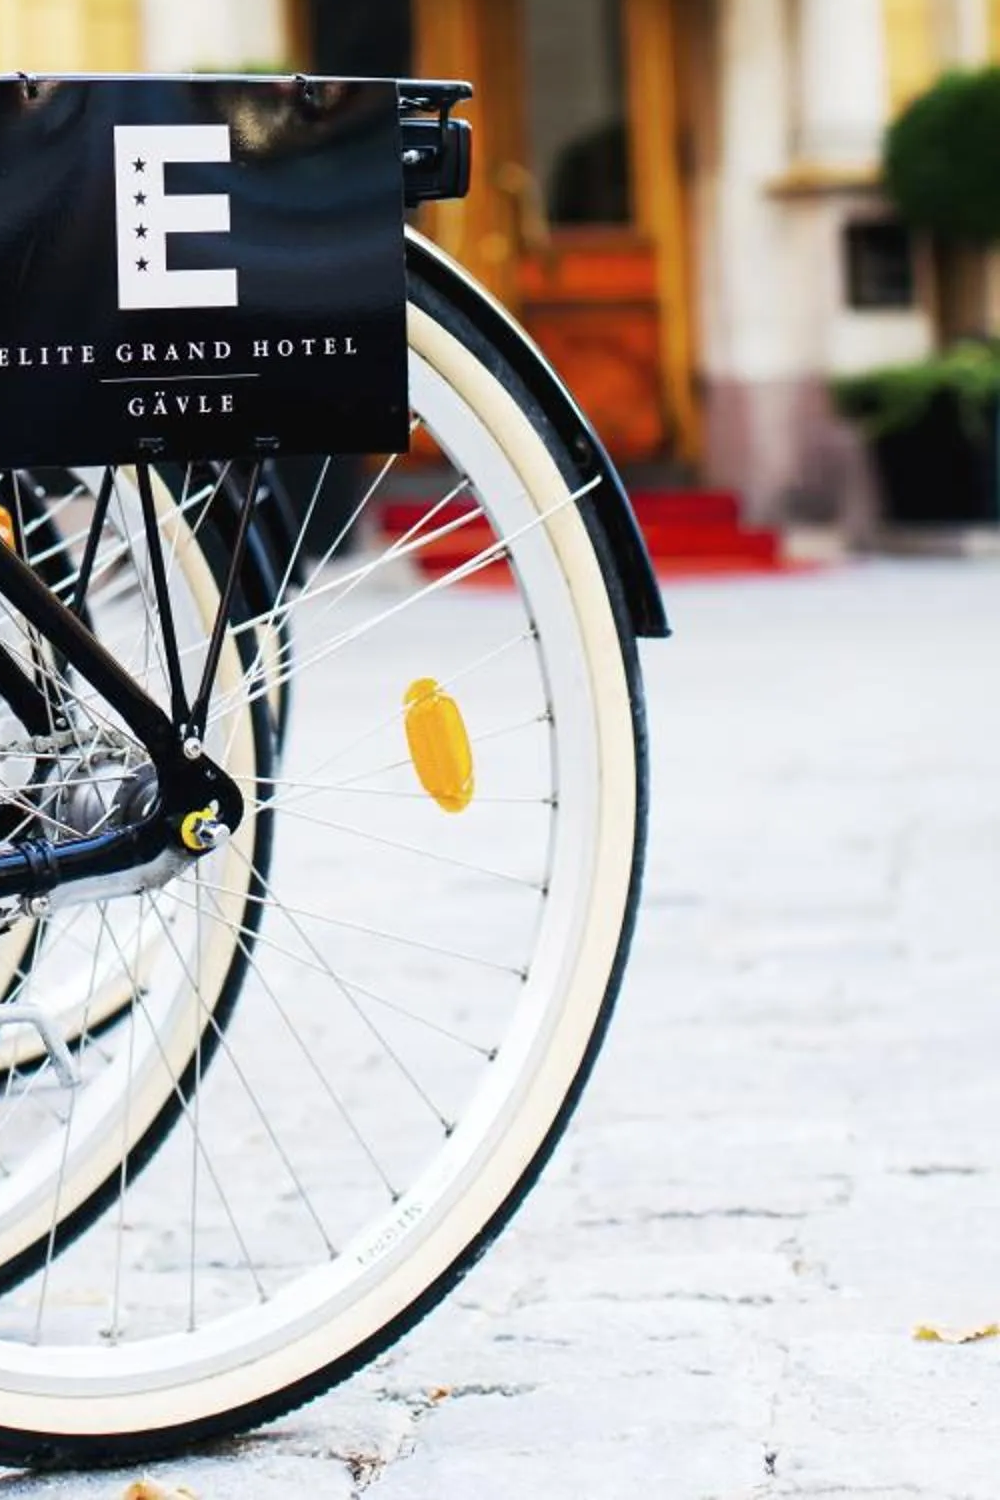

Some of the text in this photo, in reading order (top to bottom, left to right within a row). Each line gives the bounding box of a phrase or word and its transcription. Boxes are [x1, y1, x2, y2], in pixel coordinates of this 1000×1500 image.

[113, 125, 238, 310] E
[115, 341, 231, 362] GRAND
[253, 337, 357, 357] HOTEL
[127, 391, 233, 416] GÄVLE
